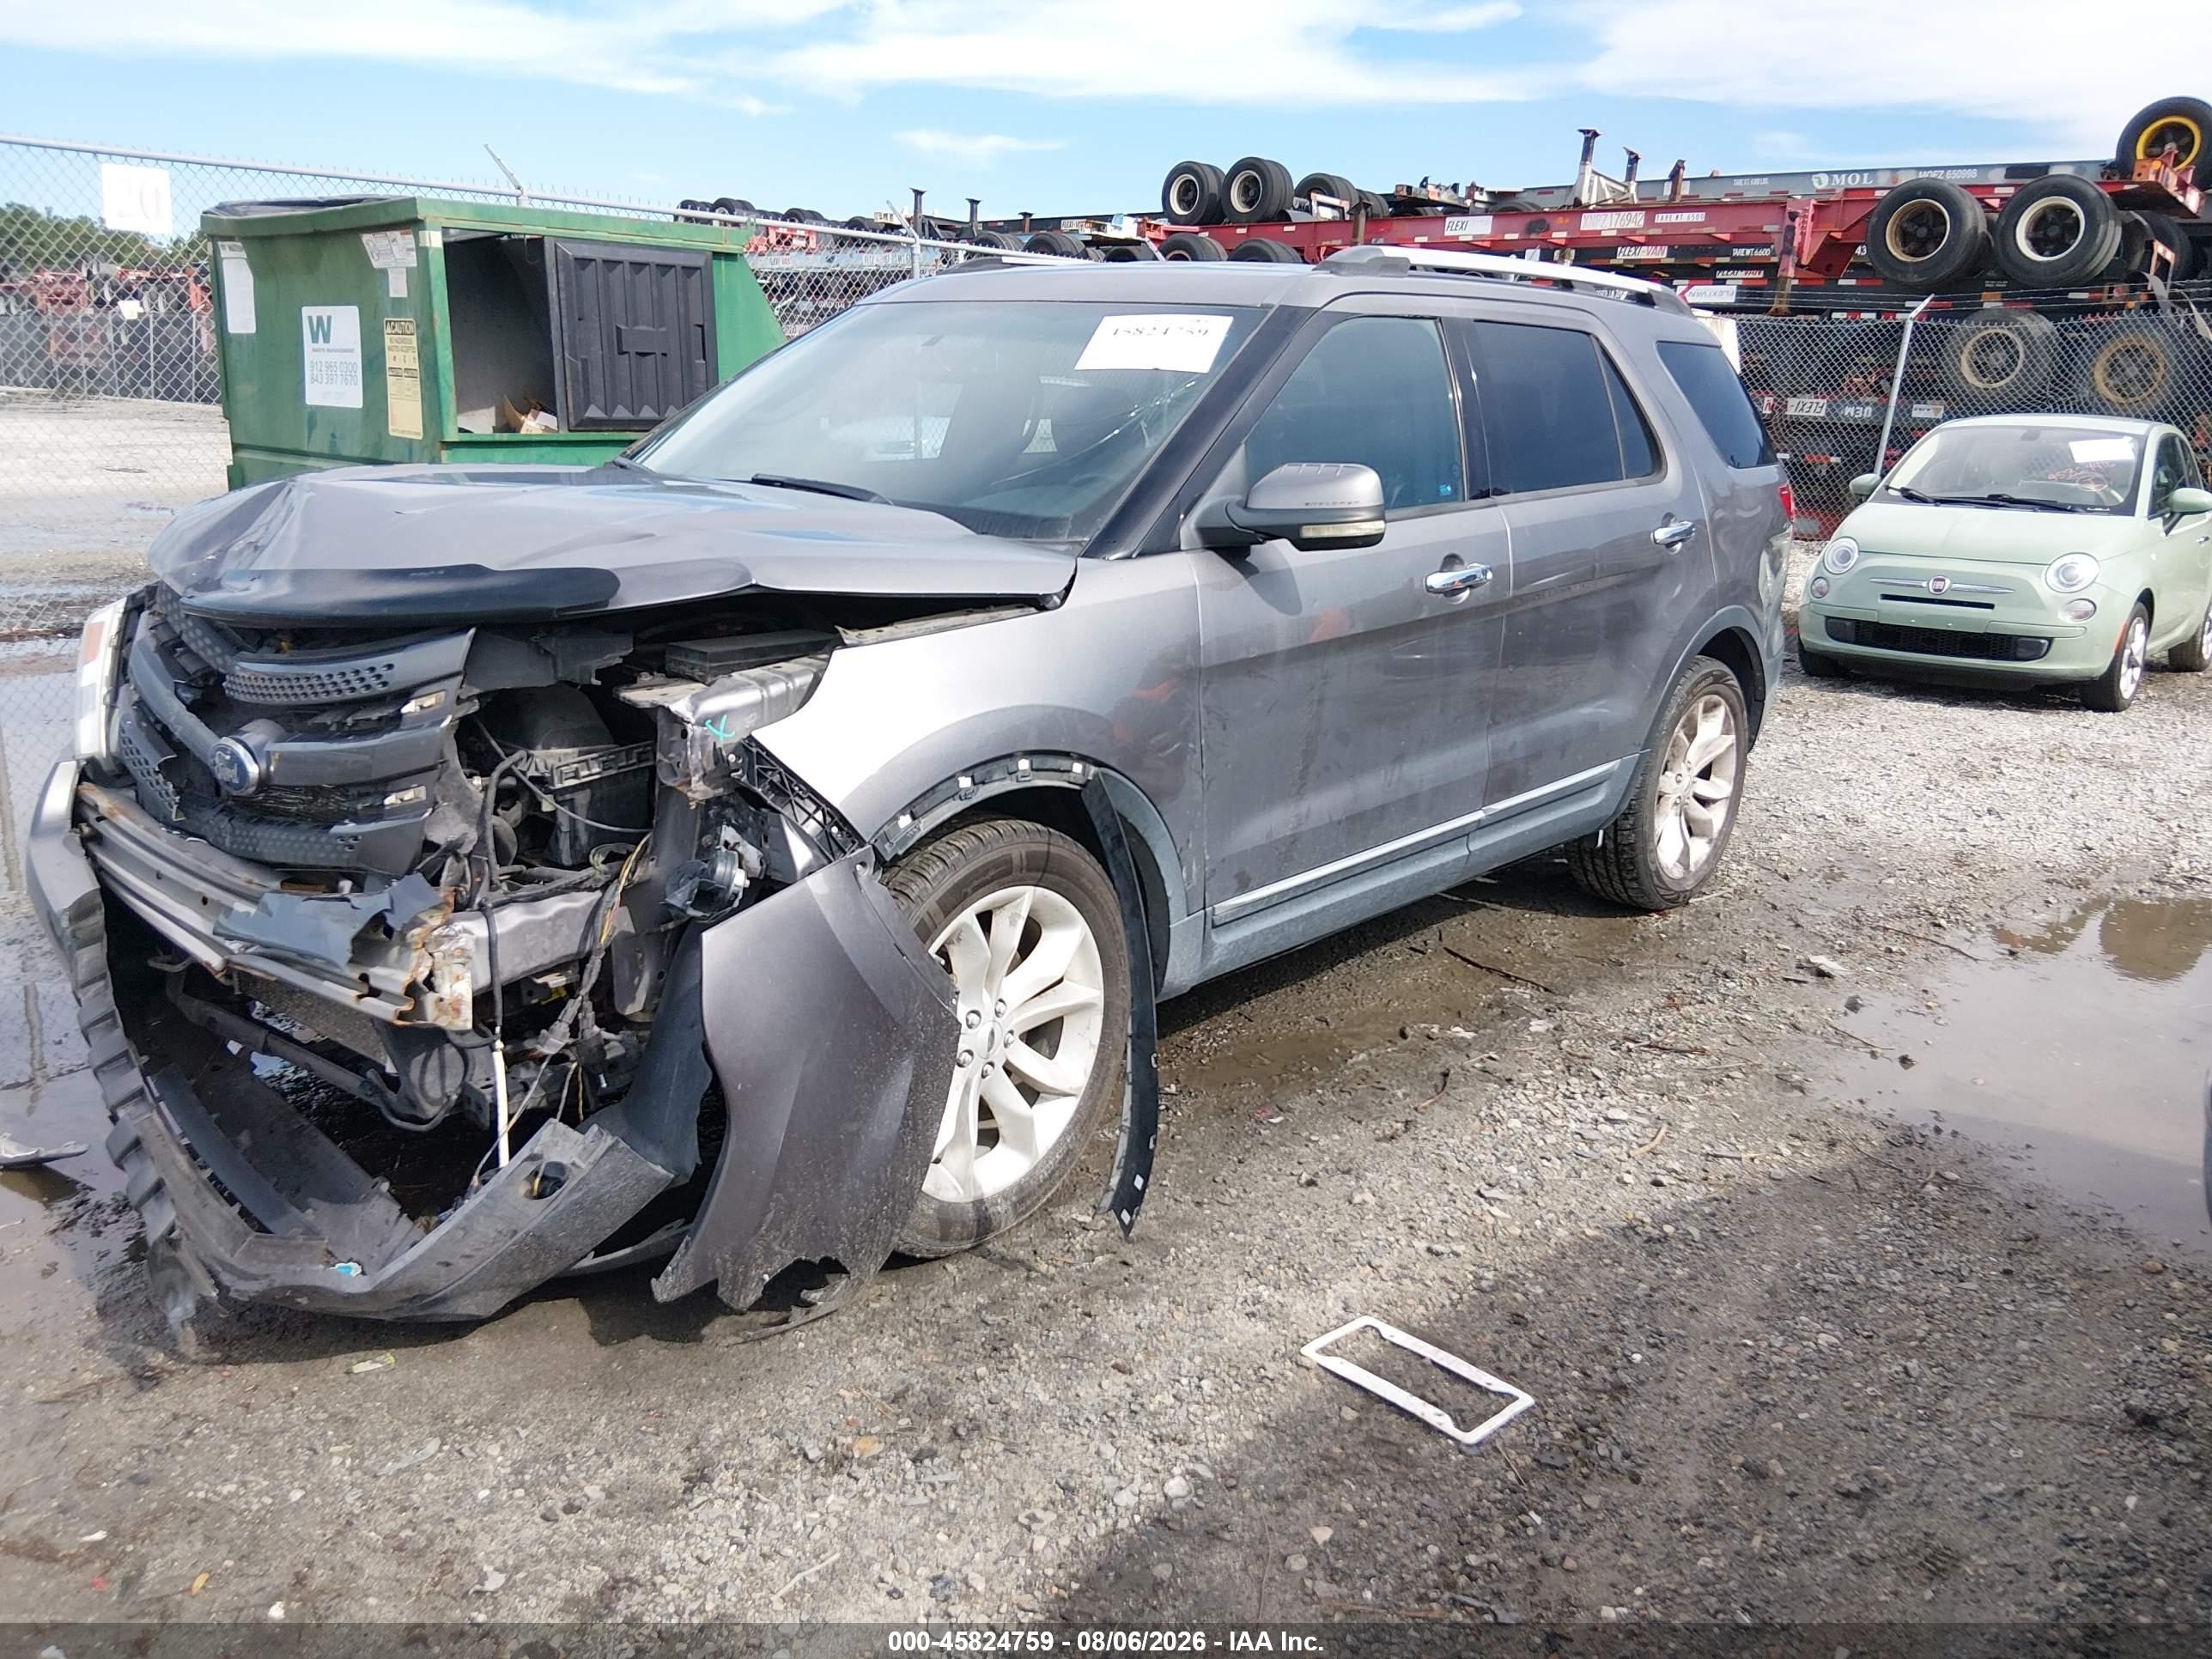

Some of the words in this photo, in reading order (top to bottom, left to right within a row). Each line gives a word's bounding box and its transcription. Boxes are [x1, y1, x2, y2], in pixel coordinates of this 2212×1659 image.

[1831, 172, 1874, 185] MOL
[1446, 220, 1469, 232] FLEXI
[307, 315, 332, 344] W
[391, 321, 415, 335] CAUTION
[339, 361, 358, 374] 0300
